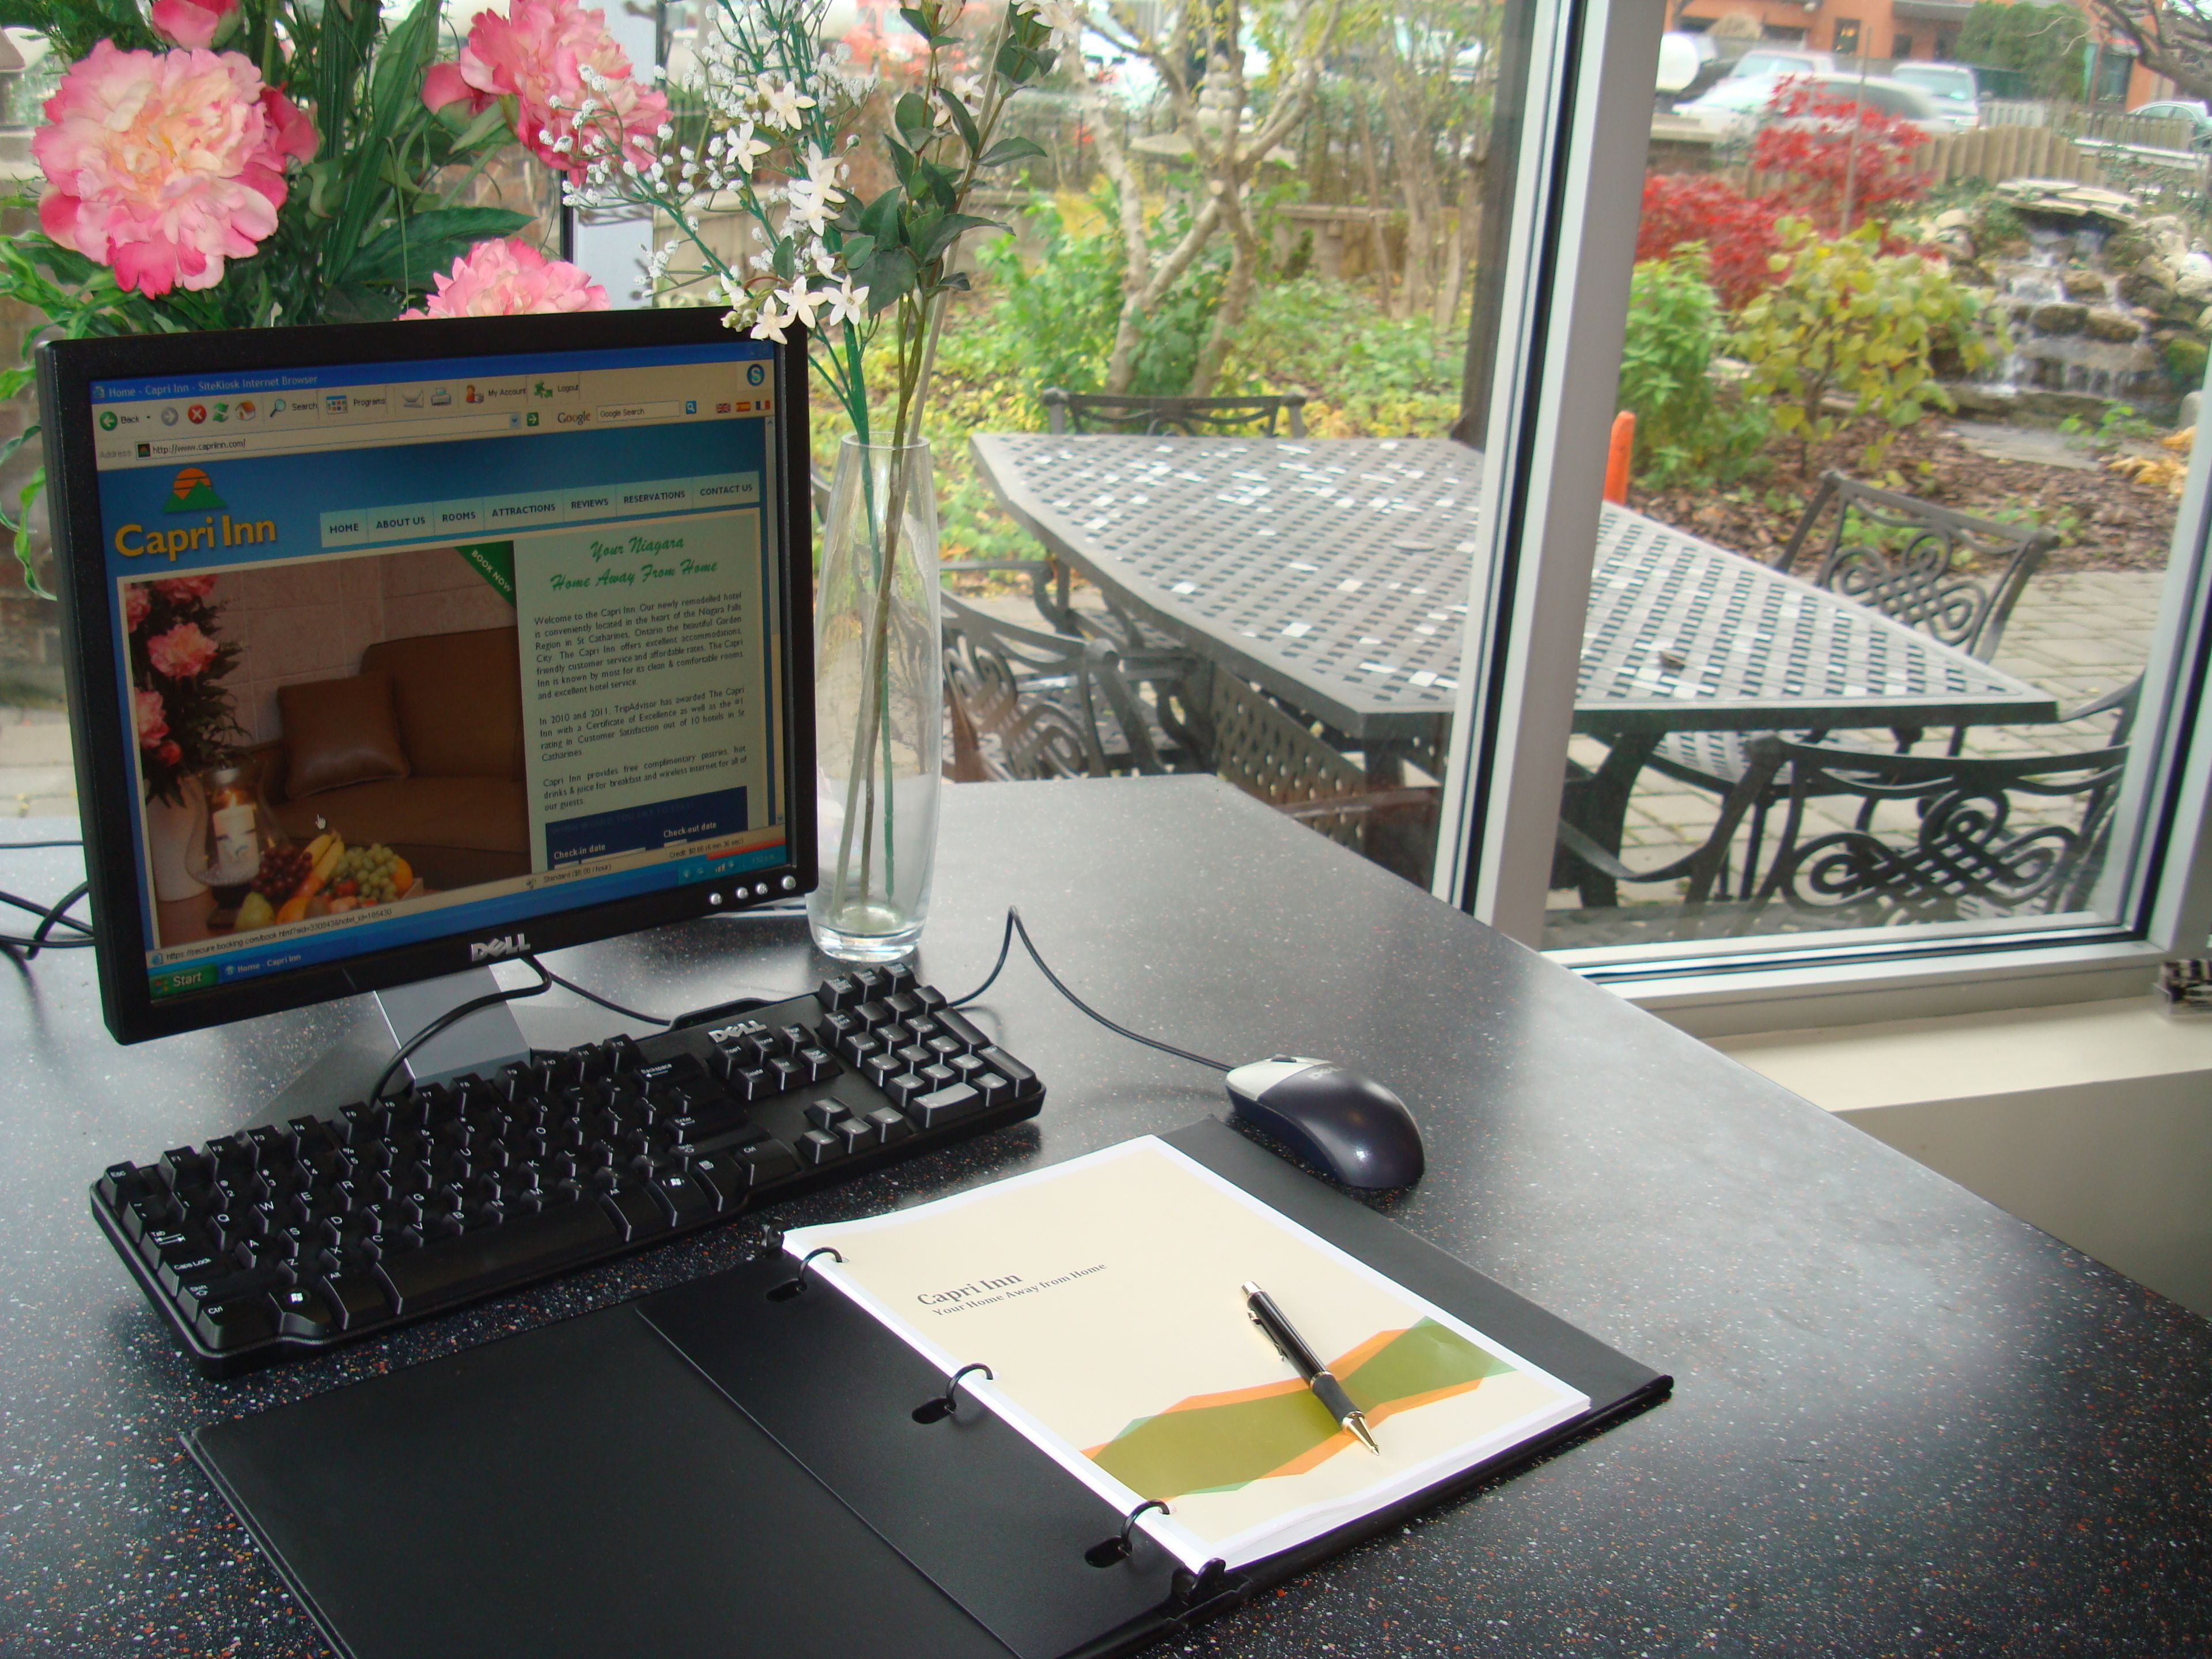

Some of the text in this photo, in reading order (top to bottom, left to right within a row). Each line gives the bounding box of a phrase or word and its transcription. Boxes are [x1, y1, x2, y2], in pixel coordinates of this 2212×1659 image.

[109, 374, 317, 397] Home Capri Inn SiteKiosk Internet Browser
[121, 384, 578, 424] Back Search Programs My Account Logout
[557, 411, 590, 424] Google
[600, 408, 644, 419] Google Search
[329, 523, 359, 533] HOME
[376, 518, 410, 529] ABOUT
[413, 517, 426, 525] US
[442, 511, 475, 522] ROOMS
[492, 503, 555, 517] ATTRACTIONS
[571, 498, 608, 509] REVIEWS
[624, 491, 685, 504] RESERVATIONS
[700, 485, 740, 496] CONTACT
[115, 516, 276, 561] Capri Inn
[590, 536, 684, 562] Your Niagara
[471, 549, 512, 592] BOOK NOW
[550, 559, 718, 591] Home Away From Home
[534, 615, 571, 626] Welcome
[586, 611, 598, 619] the
[601, 608, 621, 618] Capri
[639, 603, 655, 612] Our
[658, 600, 679, 609] newly
[724, 592, 741, 600] hotel
[544, 623, 592, 637] conveniently
[596, 619, 622, 630] located
[635, 616, 647, 625] the
[651, 614, 670, 622] heart
[673, 611, 680, 619] of
[684, 610, 695, 618] the
[699, 607, 724, 616] Niagara
[727, 604, 741, 612] Falls
[535, 641, 560, 652] Region
[635, 627, 663, 637] Ontario
[666, 624, 679, 632] the
[683, 619, 713, 630] beautiful
[716, 616, 741, 625] Garden
[559, 650, 574, 660] The
[579, 647, 599, 657] Capri
[604, 645, 615, 653] Inn
[620, 642, 641, 651] offers
[646, 637, 677, 647] excellent
[536, 664, 565, 676] friendly
[568, 660, 603, 671] customer
[607, 656, 632, 665] service
[634, 652, 647, 661] and
[650, 647, 684, 659] affordable
[709, 642, 722, 650] The
[724, 638, 743, 649] Capri
[537, 679, 550, 687] Inn
[562, 675, 587, 684] known
[590, 672, 599, 681] by
[602, 669, 620, 678] most
[623, 666, 634, 675] for
[647, 662, 665, 671] clean
[676, 654, 718, 667] comfortable
[721, 652, 743, 661] rooms
[538, 681, 609, 700] and excellent hotel
[540, 717, 547, 725] In
[551, 713, 570, 724] 2010
[573, 710, 586, 721] and
[614, 701, 657, 714] TripAdvisor
[660, 698, 672, 706] has
[676, 692, 705, 704] awarded
[709, 690, 722, 698] The
[726, 686, 744, 696] Capri
[540, 730, 552, 738] Inn
[557, 725, 573, 735] with
[586, 718, 624, 730] Certificate
[628, 714, 636, 723] of
[639, 710, 677, 722] Excellence
[691, 703, 705, 712] well
[719, 700, 732, 708] the
[541, 740, 563, 750] rating
[577, 732, 615, 744] Customer
[619, 725, 659, 737] Satisfaction
[664, 722, 675, 730] out
[680, 718, 687, 726] of
[691, 716, 700, 725] 10
[703, 712, 724, 722] hotels
[543, 745, 746, 788] Capri Inn provides free complimentary hot
[544, 788, 567, 799] drinks
[577, 785, 594, 795] juice
[596, 782, 607, 790] for
[610, 775, 642, 787] breakfast
[644, 771, 657, 781] and
[659, 768, 687, 778] wireless
[690, 762, 717, 772] internet
[740, 755, 747, 763] of
[544, 803, 558, 811] our
[471, 933, 531, 961] DELL
[173, 972, 202, 987] Start
[237, 954, 301, 973] Home Capri Inn
[708, 1020, 767, 1043] DELL
[260, 1202, 275, 1210] W
[174, 1257, 211, 1270] Caps Lock
[917, 1274, 1023, 1305] Capri Inn
[931, 1263, 1107, 1316] Your Home Away from Home
[208, 1306, 223, 1315] Ctrl
